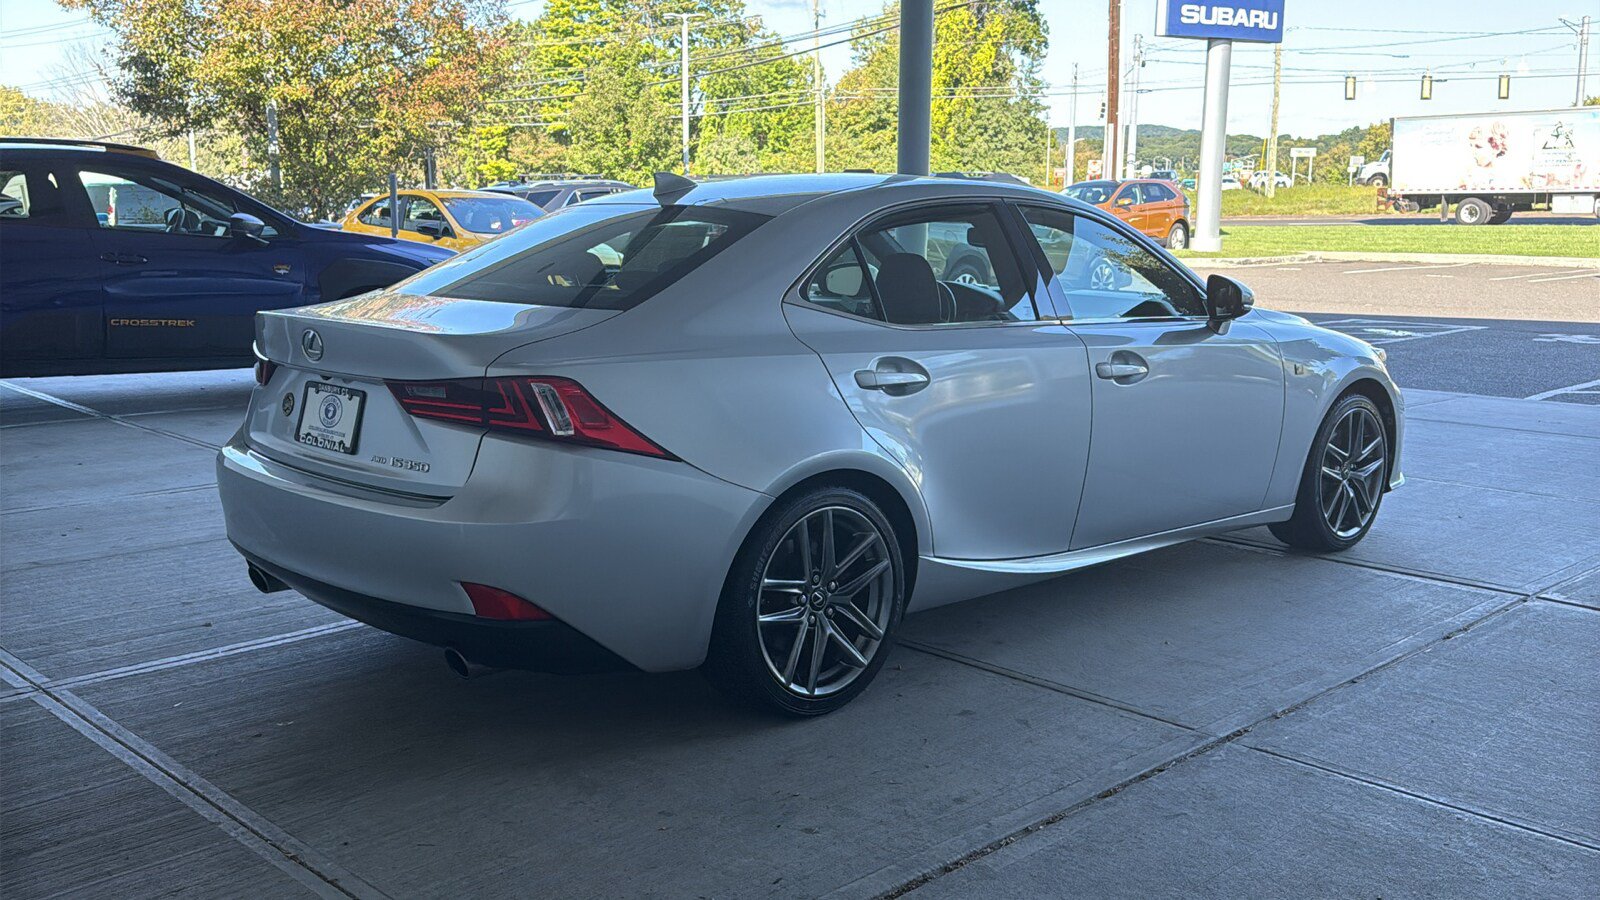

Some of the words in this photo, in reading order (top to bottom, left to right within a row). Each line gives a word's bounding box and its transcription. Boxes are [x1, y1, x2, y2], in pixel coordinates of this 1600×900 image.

[1180, 4, 1278, 30] SUBARU
[110, 318, 195, 327] CROSSTREK
[299, 434, 345, 453] COLONIAL
